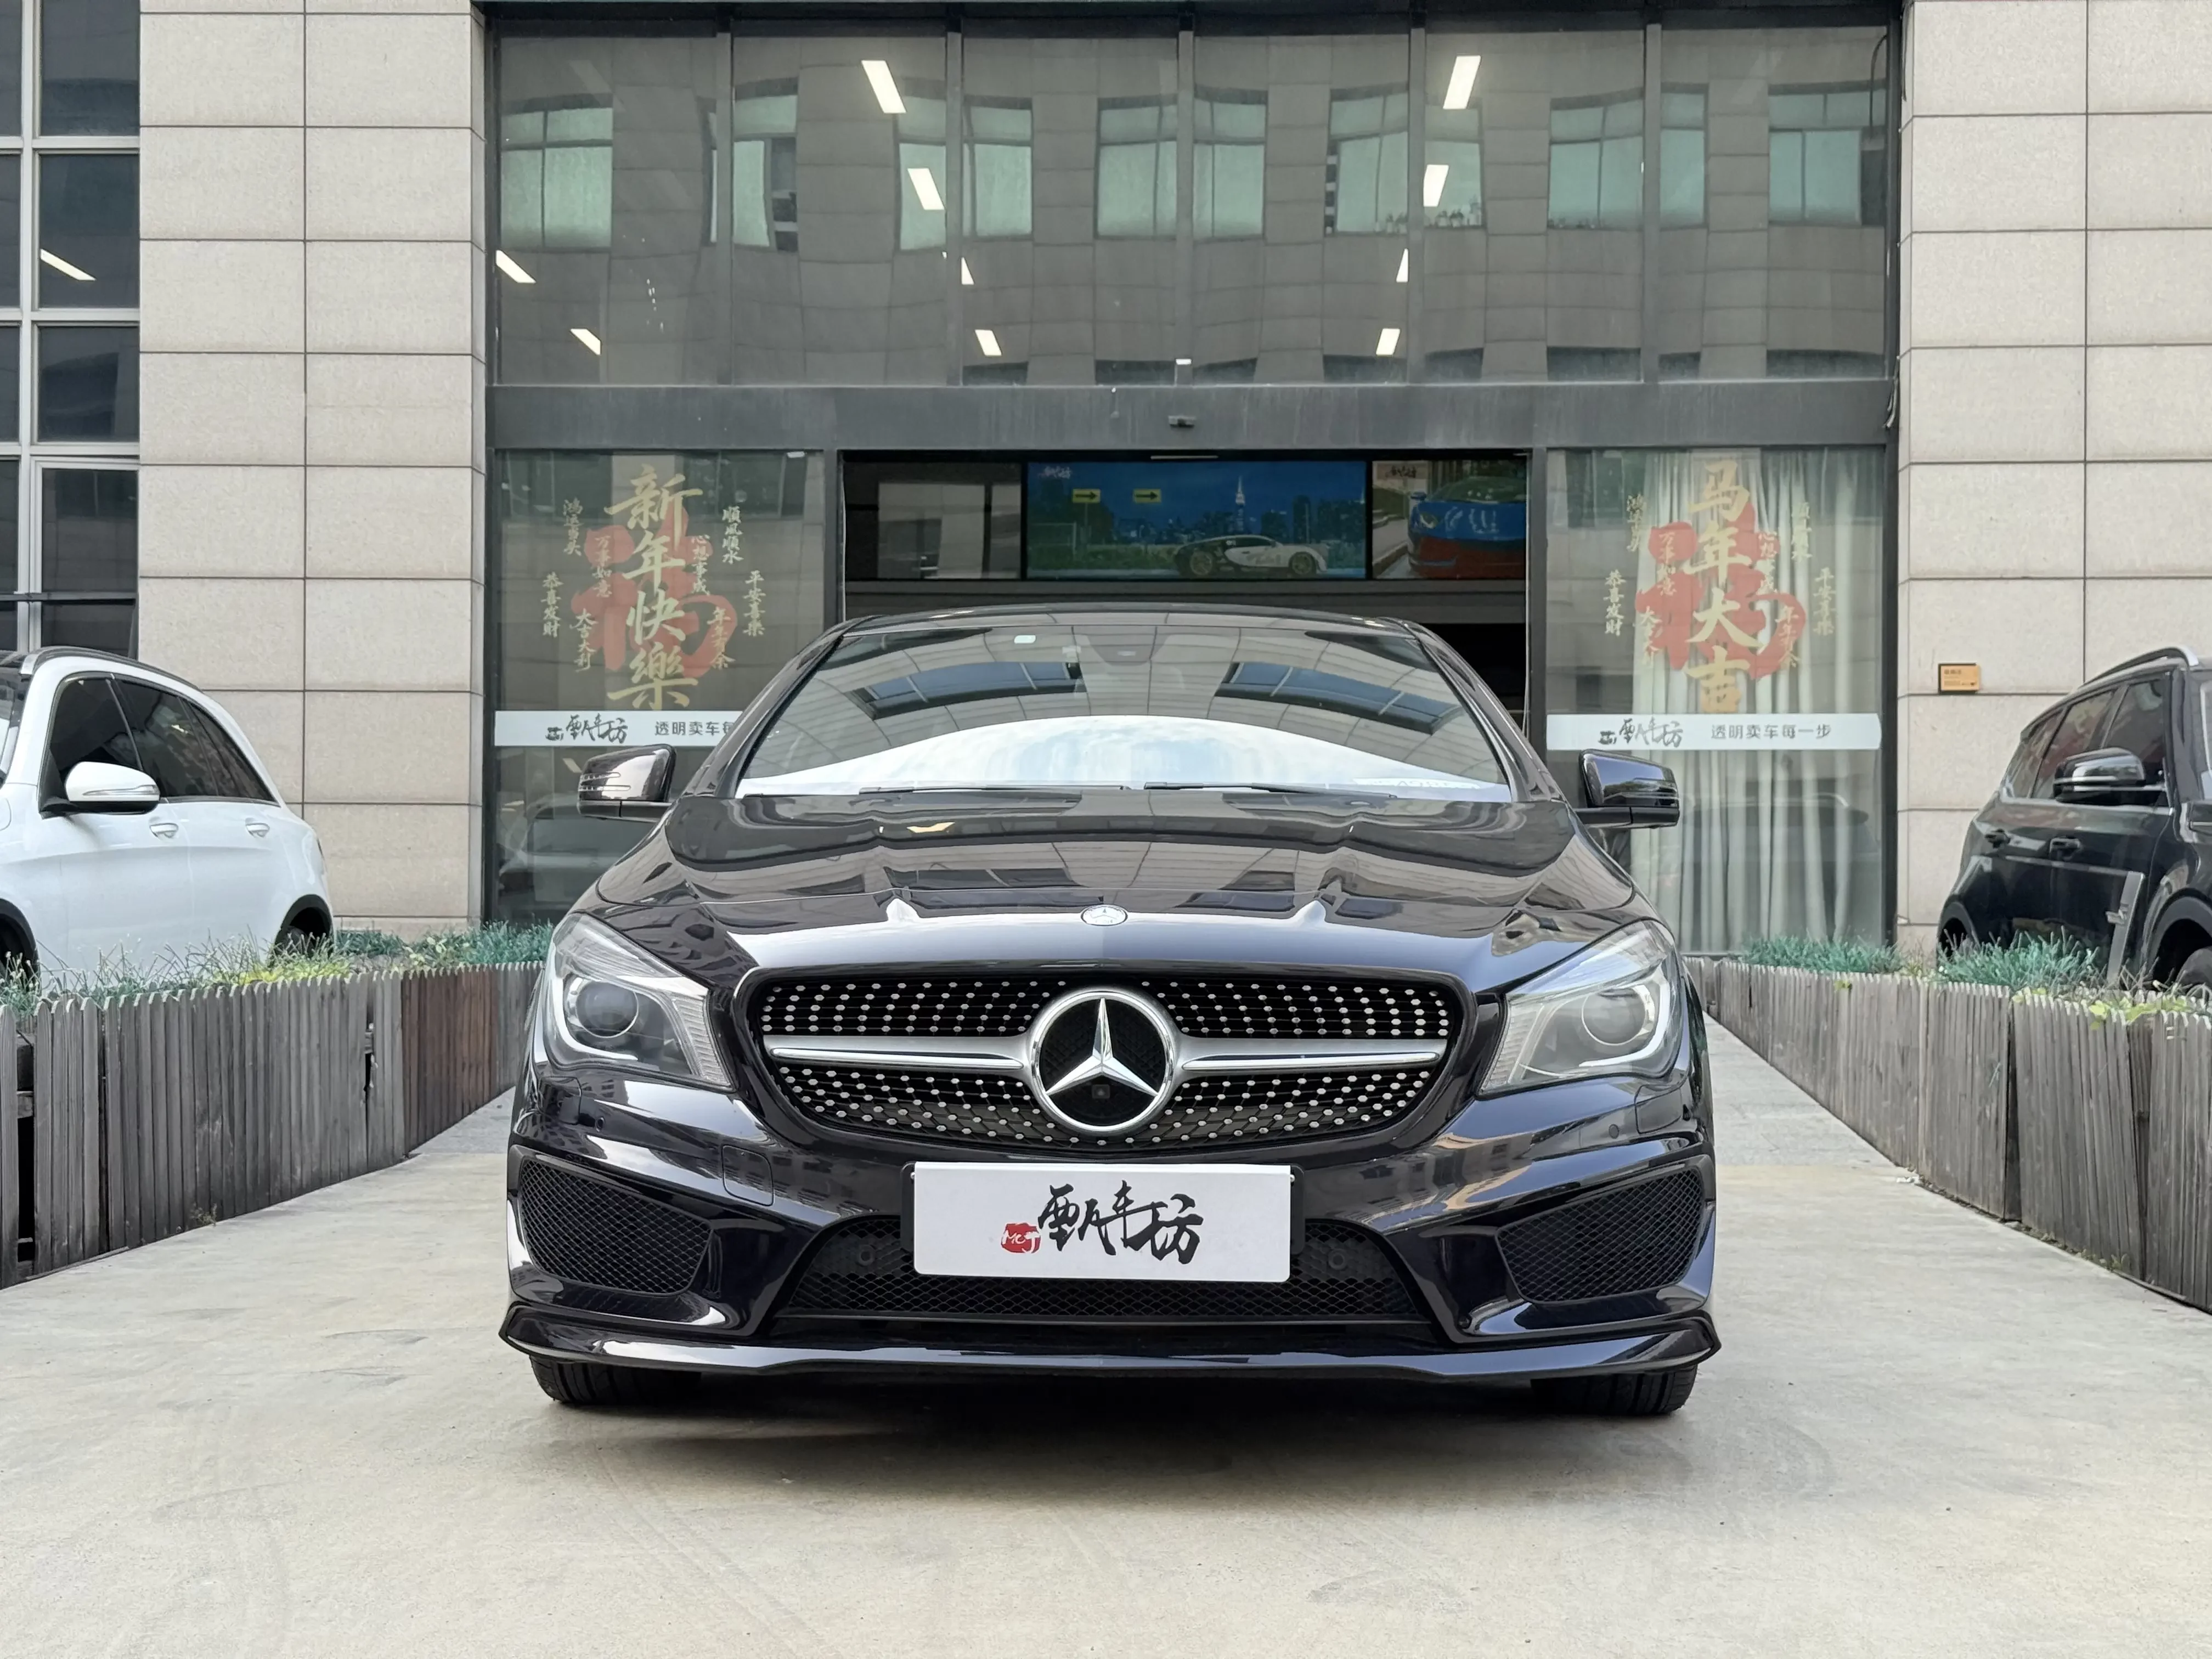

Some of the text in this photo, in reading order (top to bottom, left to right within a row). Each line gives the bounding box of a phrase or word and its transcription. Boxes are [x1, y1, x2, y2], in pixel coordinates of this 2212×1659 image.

[1711, 724, 1832, 740] 透明卖车每一步
